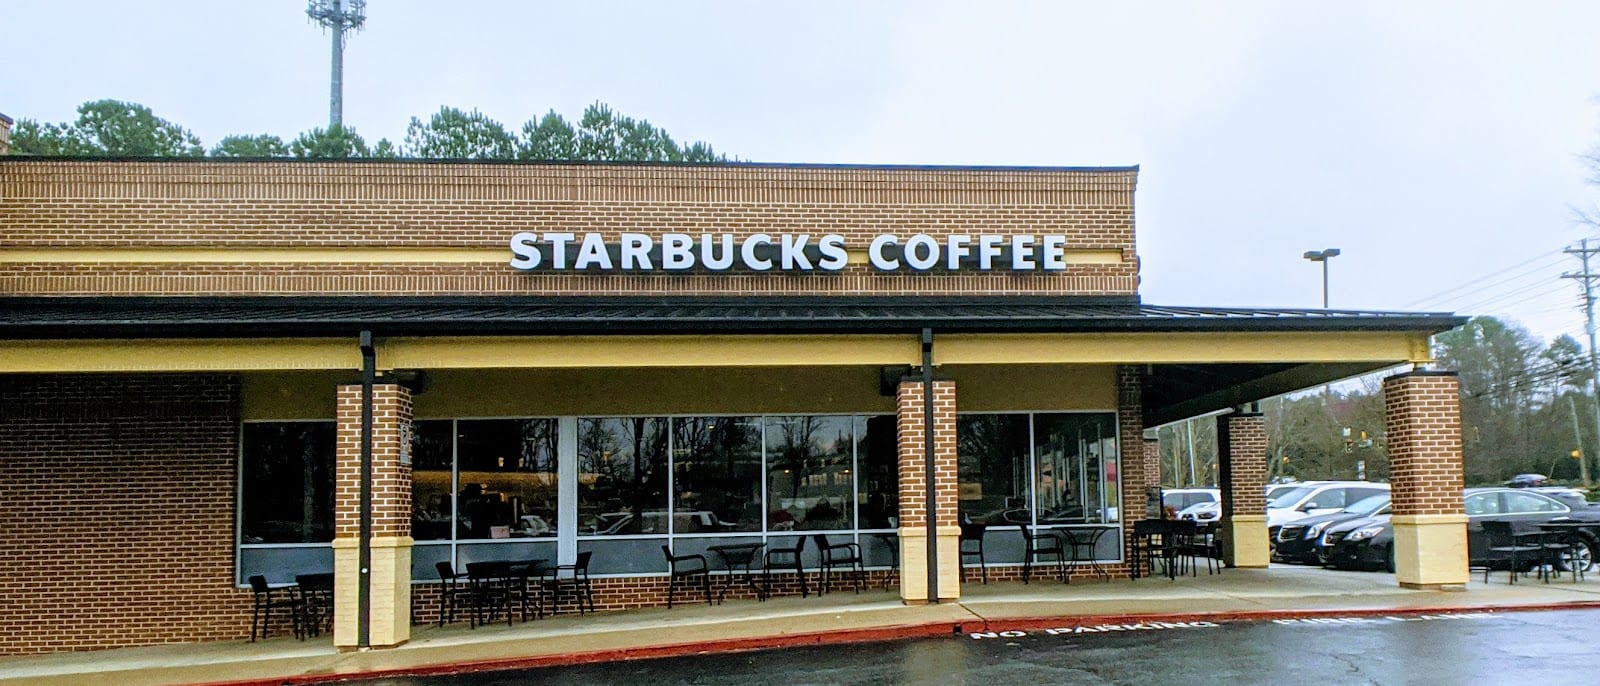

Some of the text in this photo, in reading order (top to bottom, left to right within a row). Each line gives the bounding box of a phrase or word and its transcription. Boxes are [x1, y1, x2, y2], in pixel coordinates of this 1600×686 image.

[509, 232, 1068, 272] STARBUCKS COFFEE
[969, 630, 1027, 640] NO
[1044, 620, 1220, 635] PARKING
